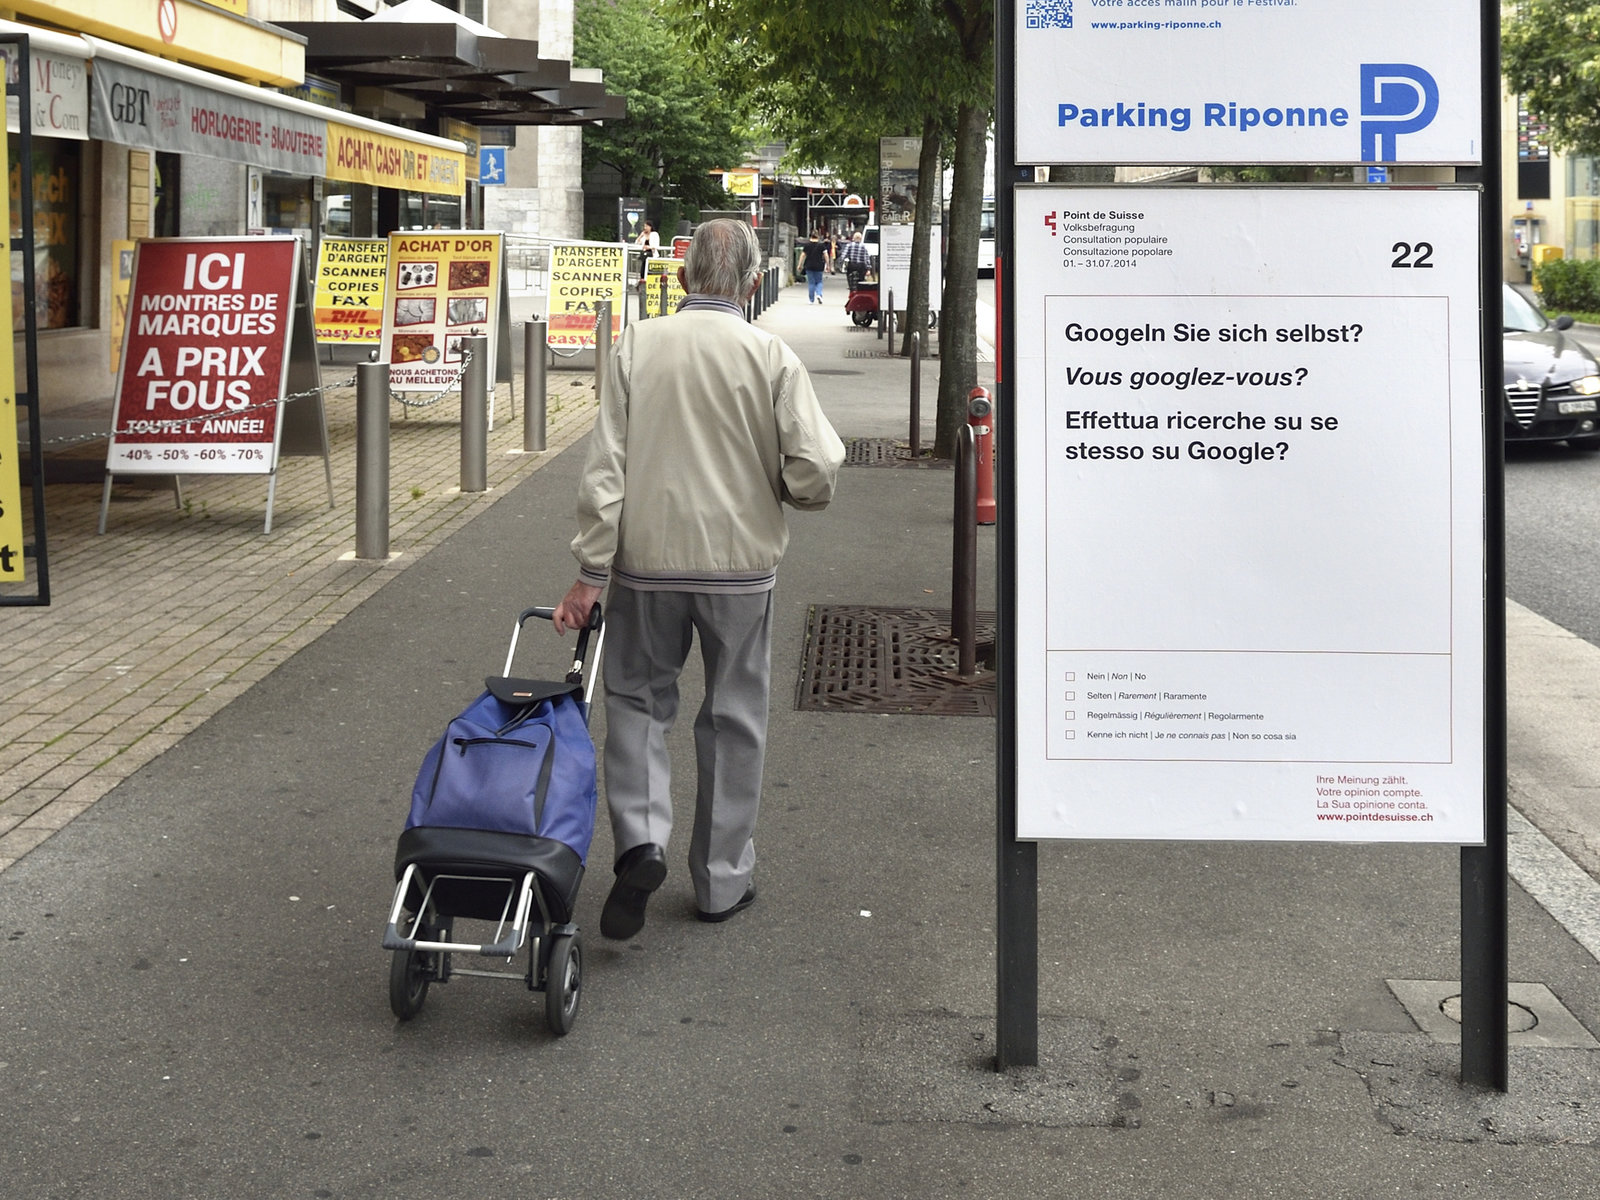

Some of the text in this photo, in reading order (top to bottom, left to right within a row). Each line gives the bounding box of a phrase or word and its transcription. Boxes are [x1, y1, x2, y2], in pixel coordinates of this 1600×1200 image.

[1091, 21, 1221, 30] www.parking-riponne.ch
[36, 57, 81, 94] Money
[110, 82, 149, 126] GBT
[35, 95, 80, 131] & Com
[1058, 102, 1348, 131] Parking Riponne
[191, 106, 262, 146] HORLOGERIE
[271, 125, 323, 158] BIJOUTERIE
[337, 136, 459, 186] ACHAT CASH OR ET ARGENT
[1064, 211, 1144, 219] Point de Suisse
[1063, 223, 1134, 233] Volksbefragung
[1063, 235, 1167, 245] Consultation populaire
[398, 240, 493, 252] ACHAT D'OR
[553, 247, 623, 257] TRANSFERT
[1064, 247, 1172, 257] Consultazione popolare
[1391, 242, 1433, 268] 22
[327, 253, 387, 263] D'ARGENT
[557, 258, 619, 267] D'ARGENT
[1086, 259, 1136, 267] 31.07.2014
[183, 253, 246, 291] ICI
[322, 266, 386, 277] SCANNER
[552, 272, 622, 282] SCANNER
[328, 281, 379, 292] COPIES
[560, 287, 613, 297] COPIES
[141, 293, 279, 312] MONTRES DE
[332, 295, 369, 306] FAX
[331, 310, 369, 323] DHL
[565, 315, 596, 329] DH
[137, 312, 276, 338] MARQUES
[1065, 323, 1363, 346] Googeln Sie sich selbst?
[136, 346, 268, 377] A PRIX
[389, 376, 402, 384] AU
[1066, 367, 1308, 390] Vous googlez-vous?
[145, 379, 252, 411] FOUS
[1066, 411, 1338, 430] Effettua ricerche su se
[126, 419, 181, 434] TOUTE
[120, 449, 264, 460] -40% -50% -60% -70%
[1066, 441, 1289, 464] stesso su Google?
[1164, 692, 1207, 700] Raramente
[1087, 711, 1138, 720] Regelmässig
[1144, 712, 1201, 720] Régulièrement
[1208, 712, 1264, 721] Regolarmente
[1317, 776, 1408, 786] Ihre Meinung zählt.
[1316, 788, 1423, 798] Votre opinion compte.
[1317, 800, 1427, 810] La Sua opinione conta.
[1317, 813, 1433, 822] www.pointdesuisse.ch
